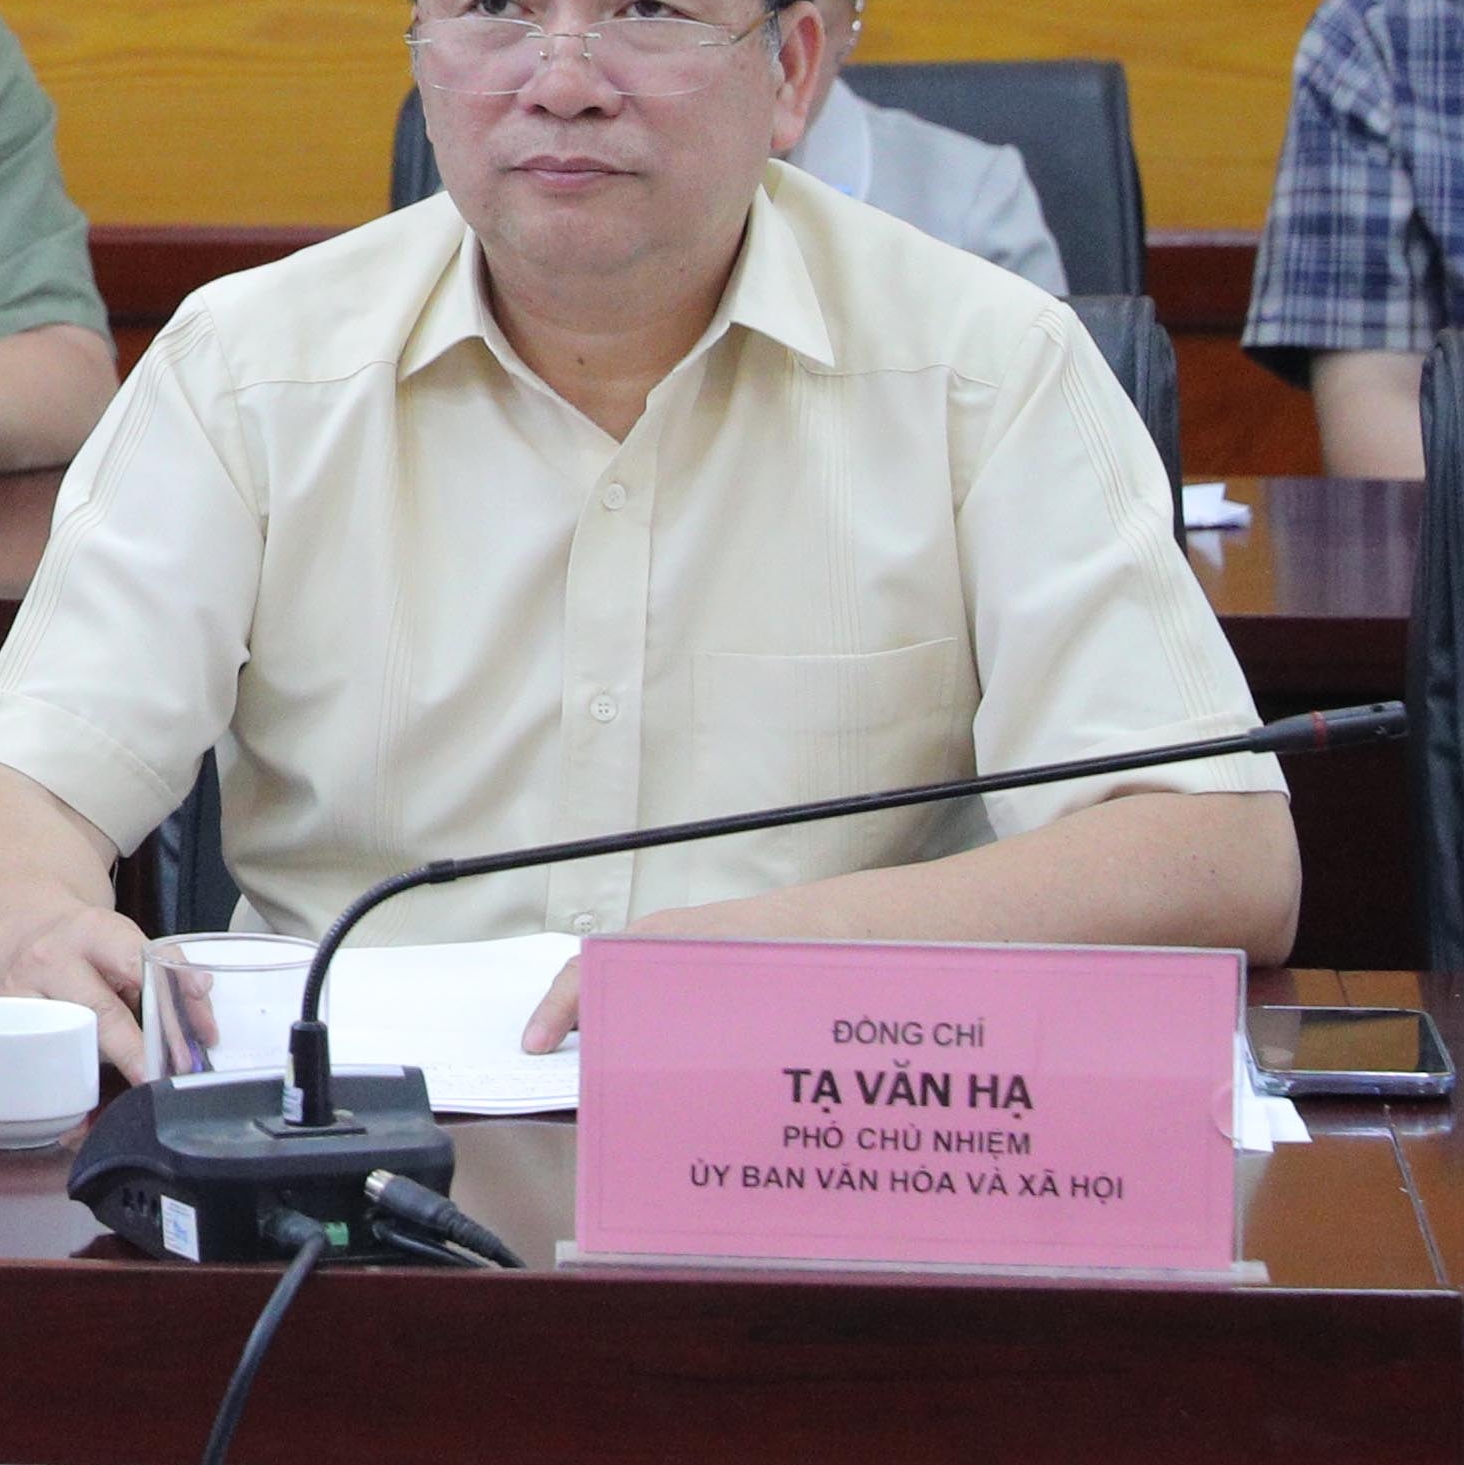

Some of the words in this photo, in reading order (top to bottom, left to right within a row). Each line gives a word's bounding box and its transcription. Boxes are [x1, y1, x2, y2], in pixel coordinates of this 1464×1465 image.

[831, 1014, 923, 1046] ĐỒNG
[932, 1017, 985, 1049] CHÍ
[782, 1067, 842, 1115] TẠ
[854, 1058, 951, 1108] VĂN
[967, 1073, 1034, 1120] HẠ
[783, 1119, 844, 1150] PHÓ
[857, 1121, 921, 1152] CHỦ
[932, 1127, 1031, 1161] NHIỆM
[691, 1157, 731, 1188] ỦY
[741, 1164, 806, 1190] BAN
[816, 1162, 879, 1192] VĂN
[890, 1164, 957, 1194] HÓA
[966, 1167, 1009, 1196] VÀ
[1018, 1168, 1061, 1198] XÃ
[1070, 1170, 1124, 1205] HỘI
